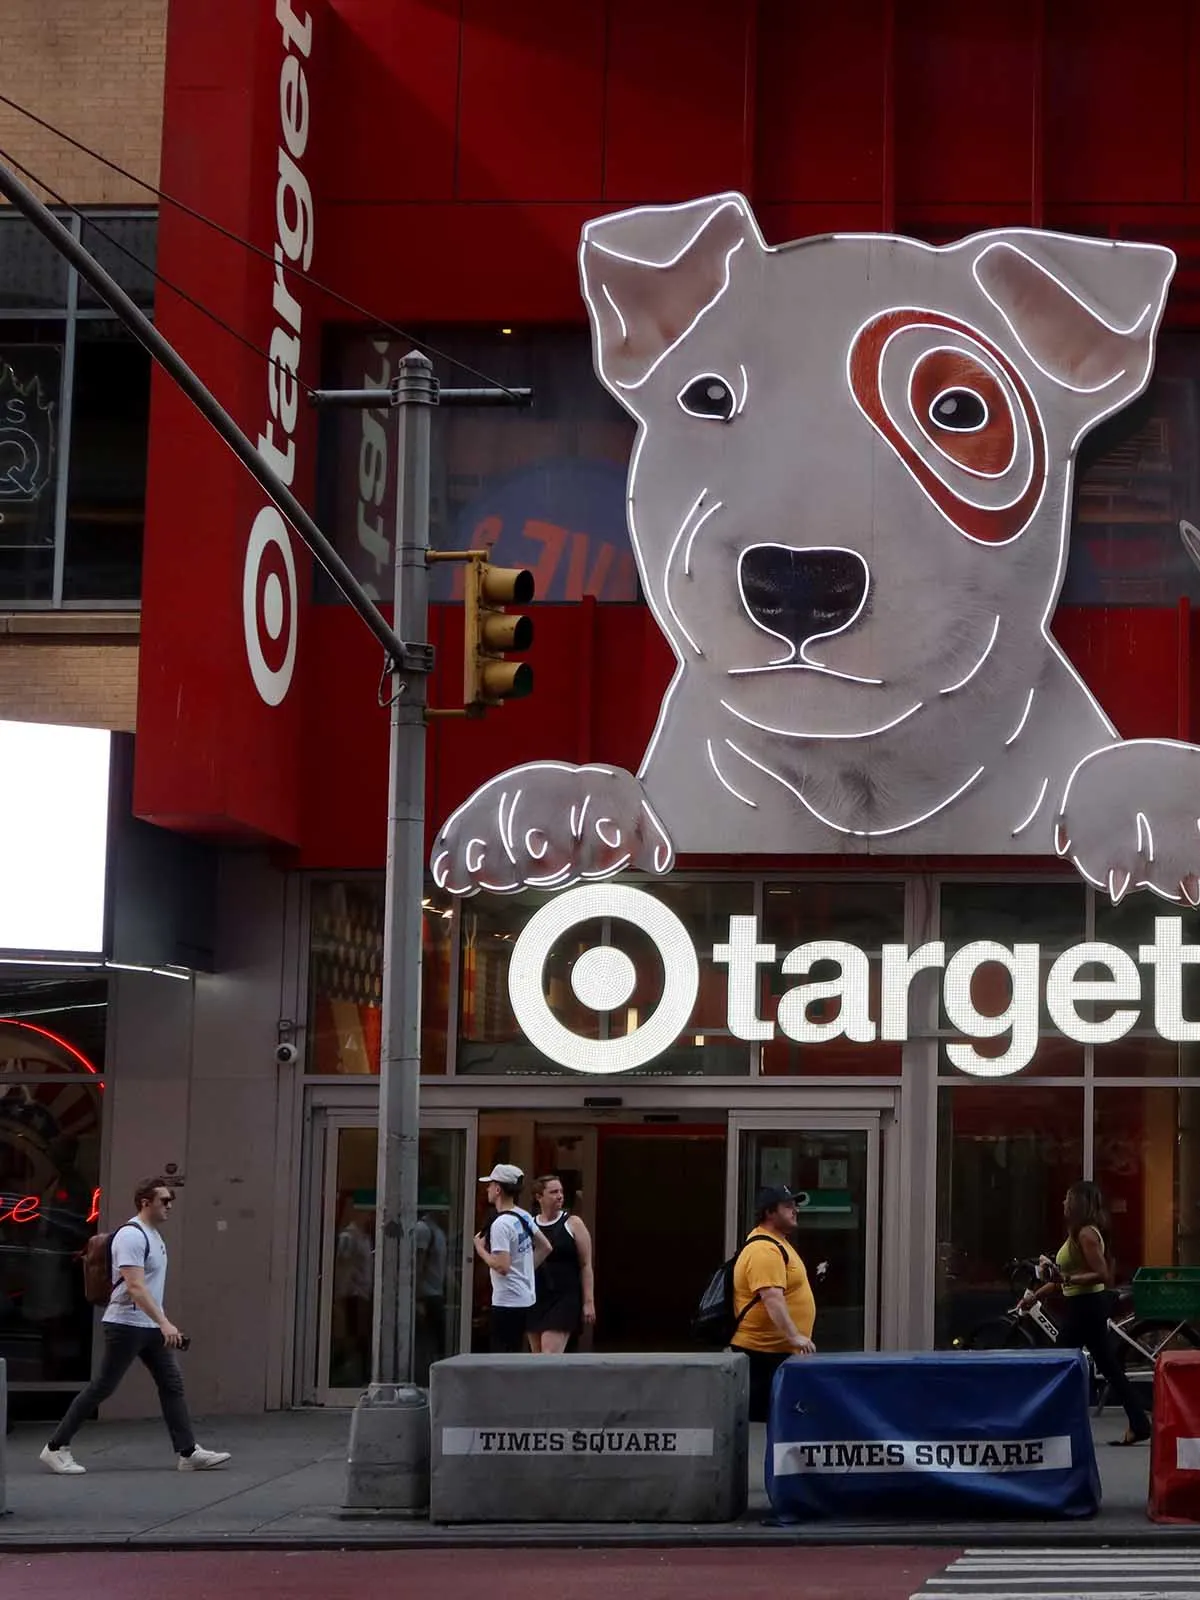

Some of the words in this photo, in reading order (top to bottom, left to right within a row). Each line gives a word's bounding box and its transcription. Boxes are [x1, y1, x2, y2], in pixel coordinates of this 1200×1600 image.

[257, 0, 314, 486] target
[479, 1432, 564, 1452] TIMES
[572, 1431, 677, 1453] SQUARE
[800, 1444, 905, 1467] TIMES
[915, 1442, 1044, 1469] SQUARE
